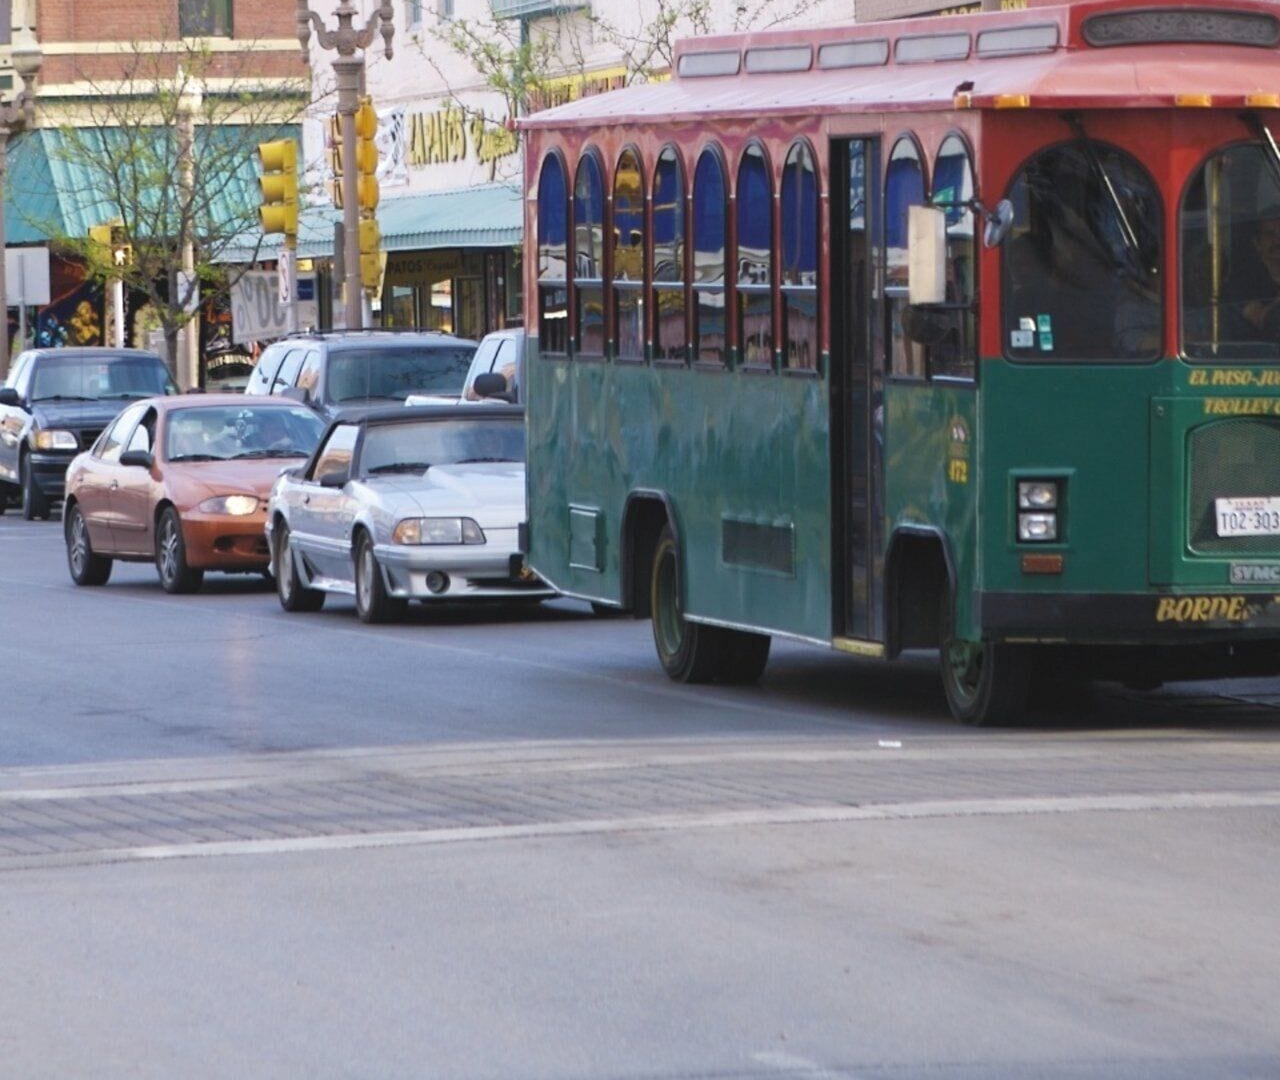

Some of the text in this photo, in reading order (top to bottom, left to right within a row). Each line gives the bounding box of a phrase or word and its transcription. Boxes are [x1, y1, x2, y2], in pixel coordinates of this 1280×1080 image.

[407, 107, 466, 165] ZAPATOS
[1189, 369, 1209, 386] EL
[1204, 398, 1273, 415] TROLLEY
